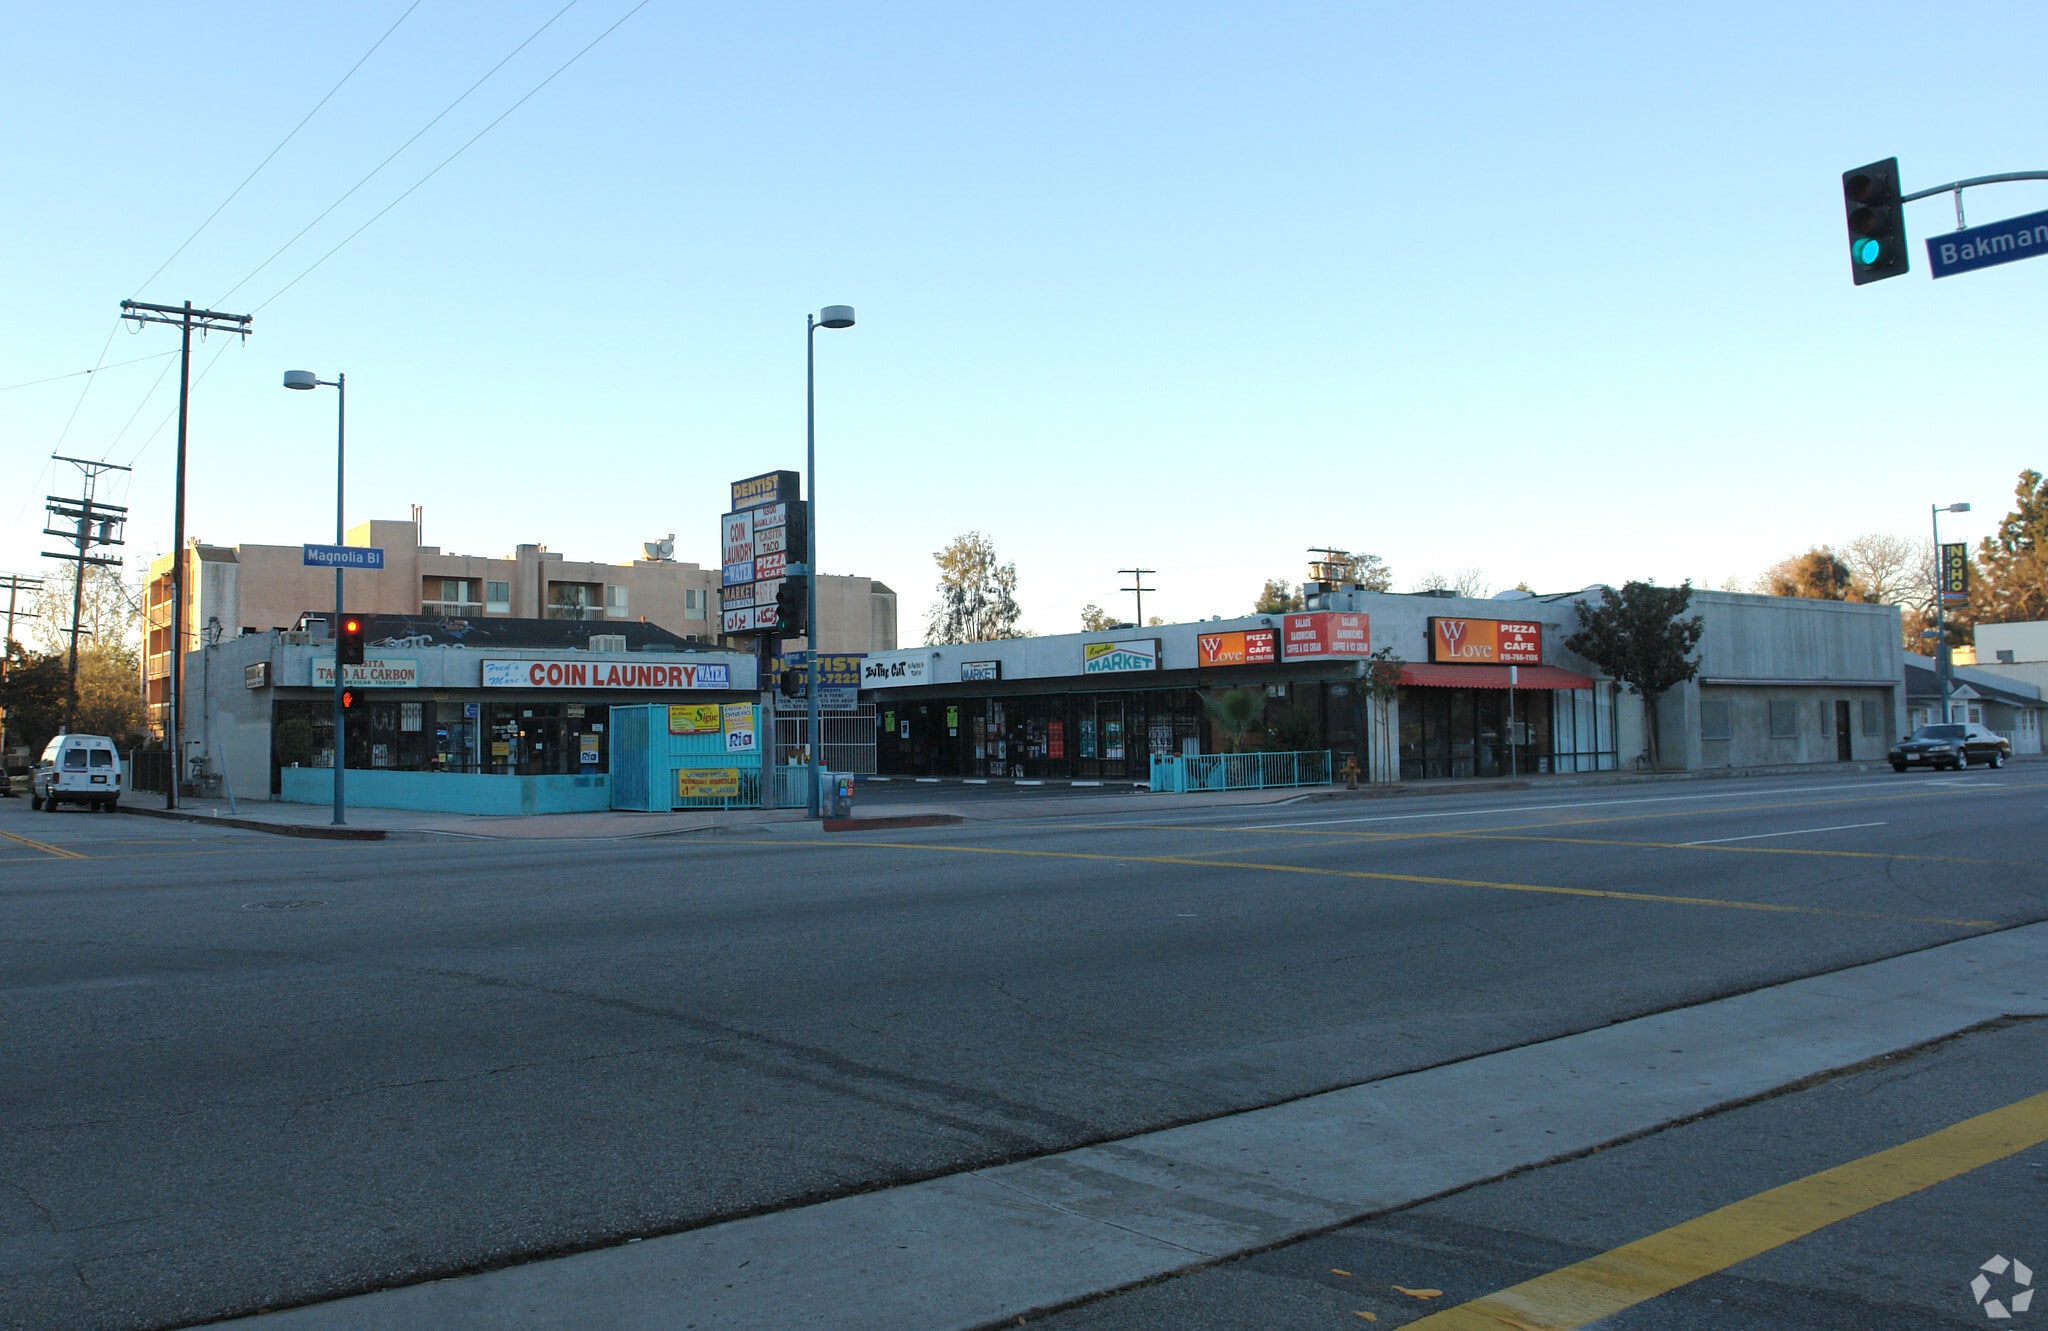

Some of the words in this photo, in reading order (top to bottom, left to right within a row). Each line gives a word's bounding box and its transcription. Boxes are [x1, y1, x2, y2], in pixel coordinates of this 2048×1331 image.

[1940, 225, 2048, 265] Bakman
[733, 474, 778, 498] DENTIST
[730, 522, 745, 543] COIN
[724, 542, 752, 564] LAUNDRY
[763, 541, 779, 553] TACO
[308, 549, 363, 565] Magnolia
[757, 554, 786, 570] PIZZA
[729, 563, 752, 581] WATER
[757, 571, 763, 579] &
[764, 568, 786, 578] CAFE
[1950, 545, 1963, 591] NOHO
[724, 584, 753, 601] MARKET
[1246, 633, 1273, 641] PIZZA
[1440, 621, 1465, 639] W
[1501, 624, 1536, 634] PIZZA
[1202, 637, 1221, 651] W
[1504, 642, 1535, 651] CAFE
[771, 657, 860, 672] DETIST
[1088, 652, 1152, 672] MARKET
[352, 669, 368, 680] AL
[371, 668, 415, 680] CARBON
[529, 663, 586, 686] COIN
[592, 664, 697, 687] LAUNDRY
[697, 665, 726, 681] WATER
[963, 668, 995, 680] MARKET
[695, 707, 718, 724] Sigue
[729, 732, 752, 747] Ria
[582, 752, 597, 761] Ria
